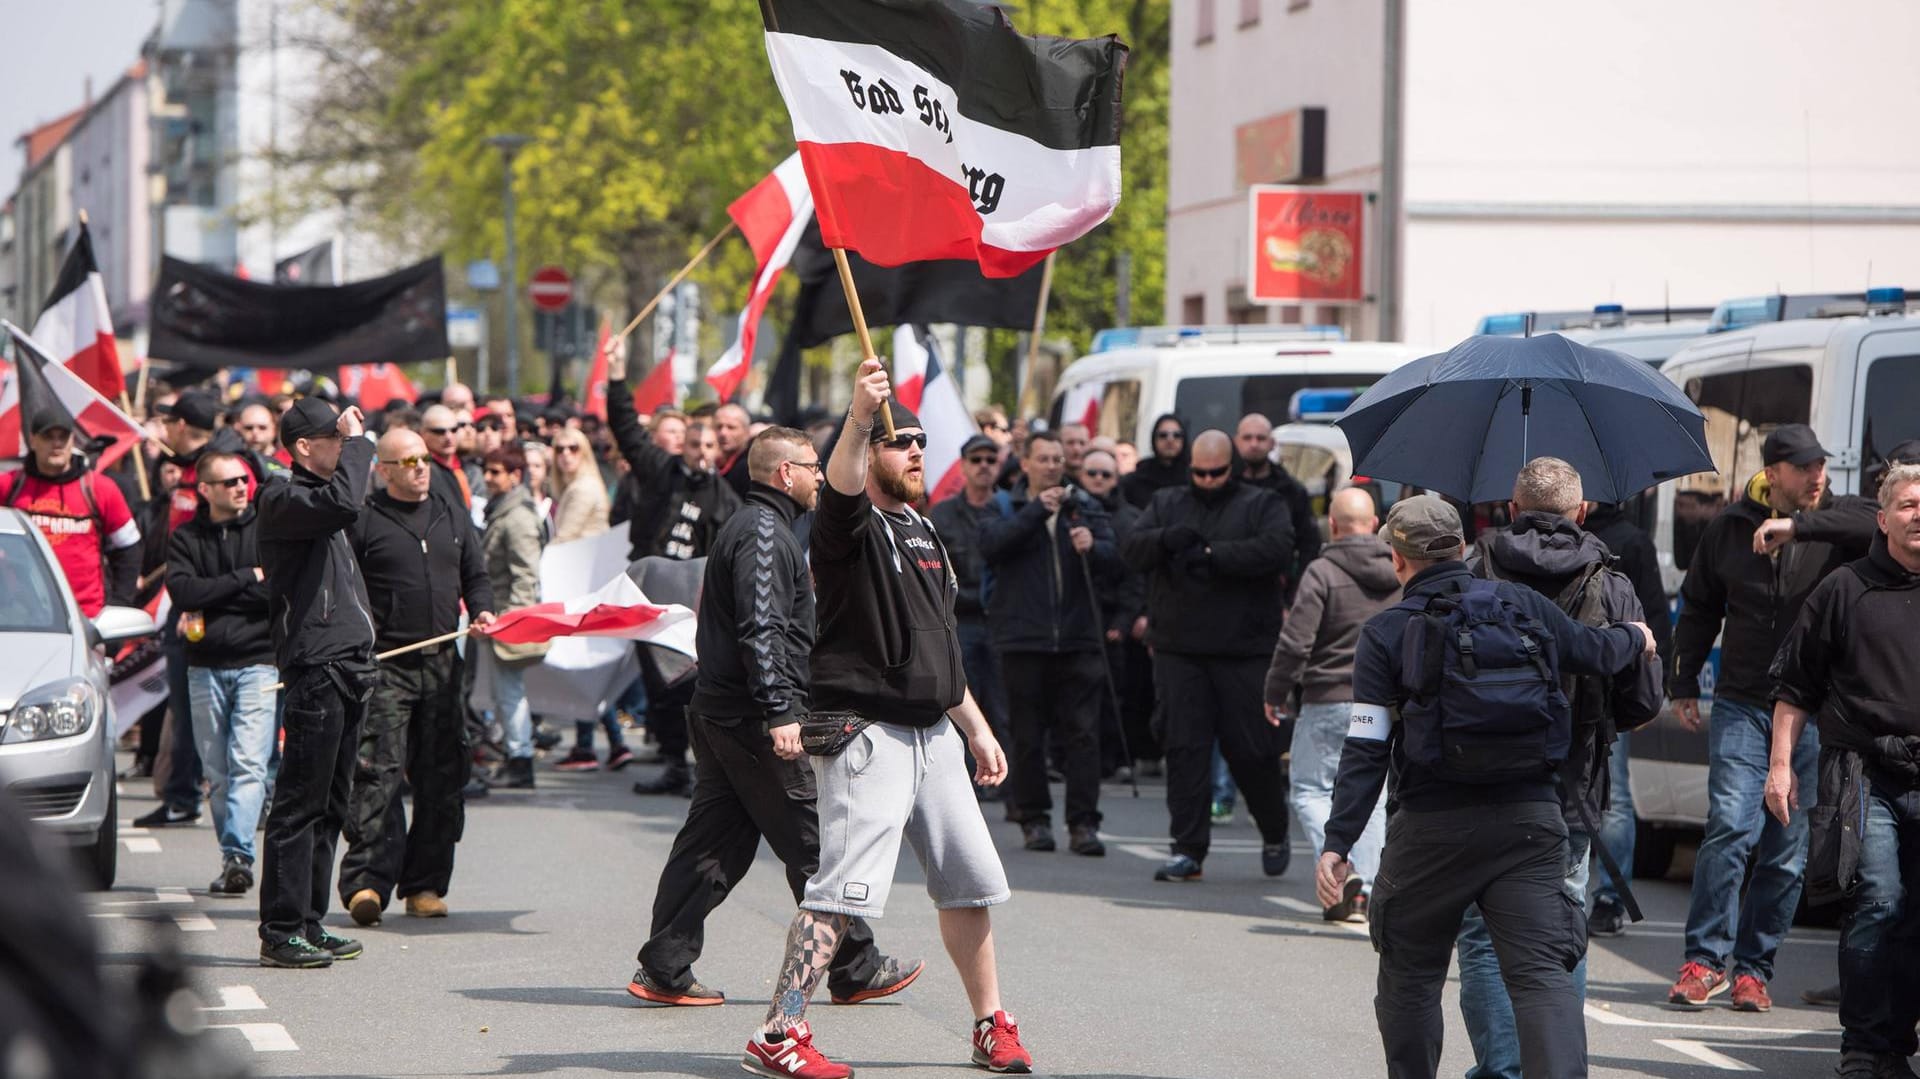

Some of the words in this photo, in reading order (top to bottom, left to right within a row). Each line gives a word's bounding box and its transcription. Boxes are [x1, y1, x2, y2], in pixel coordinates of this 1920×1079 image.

[840, 69, 904, 115] Bad
[983, 1034, 996, 1055] N
[779, 1051, 807, 1073] N
